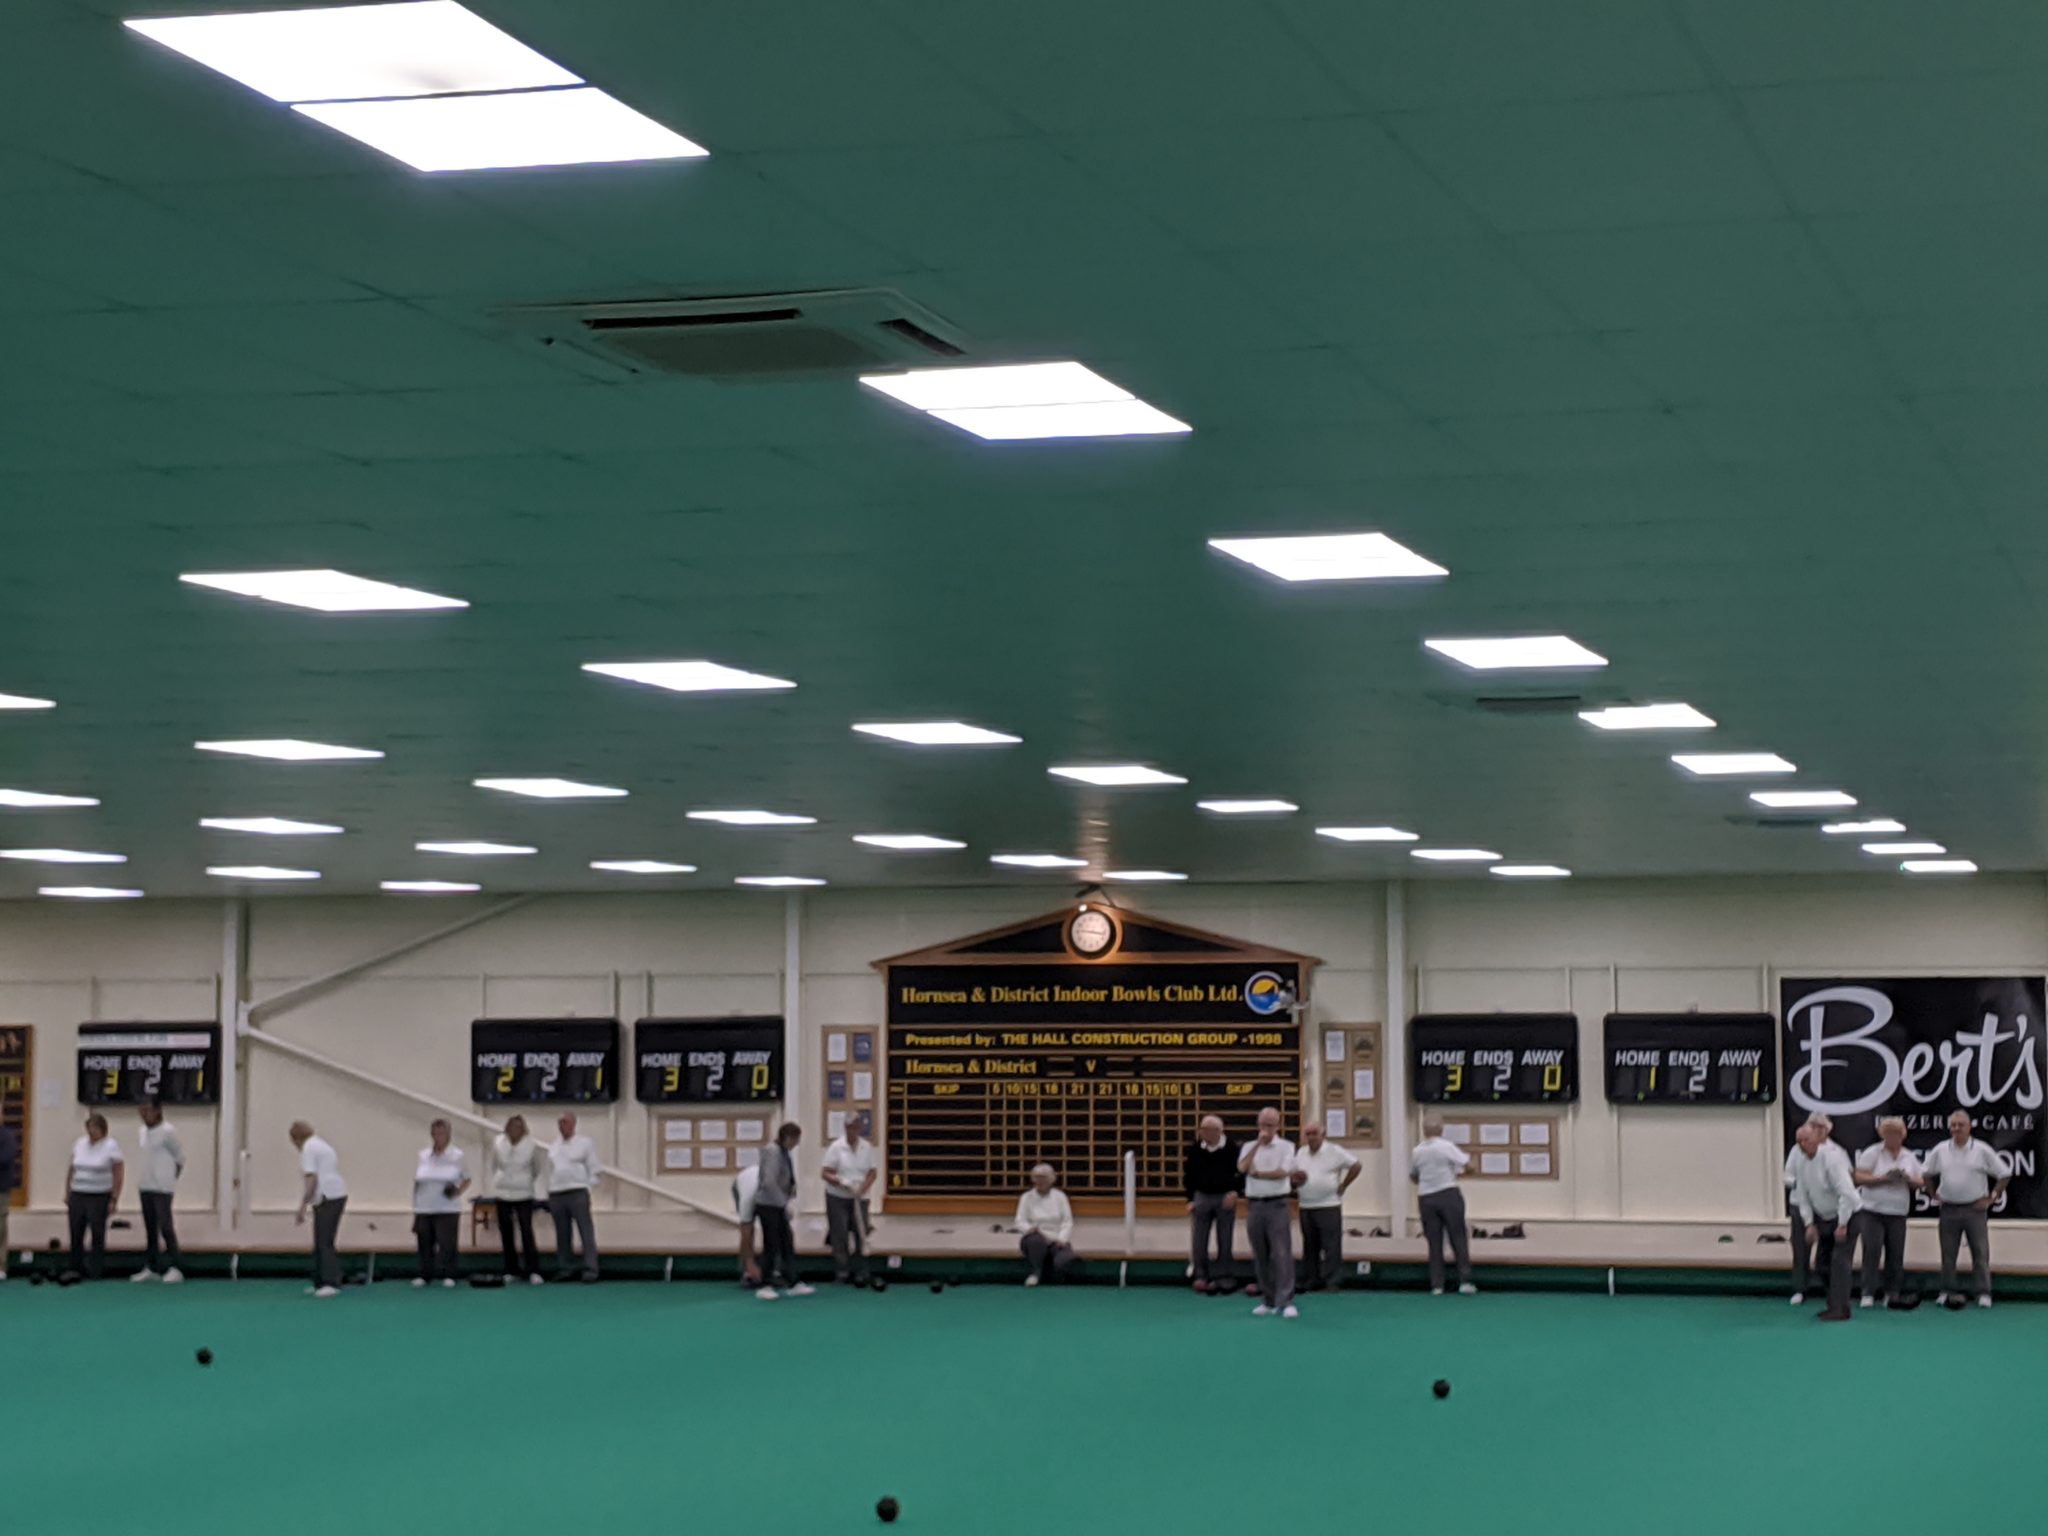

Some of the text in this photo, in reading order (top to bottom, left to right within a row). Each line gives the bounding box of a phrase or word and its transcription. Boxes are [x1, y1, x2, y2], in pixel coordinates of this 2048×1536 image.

[902, 984, 1243, 1003] Hornsea & District Indoor Bowls Club Ltd.
[905, 1033, 971, 1046] Presented
[975, 1033, 996, 1047] by:
[1002, 1033, 1028, 1045] THE
[1032, 1033, 1067, 1045] HALL
[1071, 1033, 1184, 1045] CONSTRUCTION
[1187, 1033, 1238, 1045] GROUP
[641, 1051, 771, 1067] HOME ENDS AWAY
[1421, 1050, 1564, 1067] HOME ENDS AWAY
[1615, 1050, 1762, 1067] HOME ENDS AWAY
[1787, 985, 2044, 1116] Bert's
[83, 1054, 206, 1070] HOME ENDS AWAY
[478, 1052, 604, 1068] HOME ENDS AWAY
[905, 1059, 964, 1074] Hornsea
[967, 1059, 980, 1073] &
[984, 1059, 1037, 1074] District
[104, 1069, 119, 1095] 3
[144, 1069, 161, 1094] 2
[497, 1067, 515, 1092] 2
[541, 1067, 558, 1092] 2
[663, 1064, 769, 1091] 3 2 0
[1445, 1065, 1562, 1091] 3 2 0
[1688, 1066, 1707, 1092] 2
[934, 1084, 960, 1094] SKIP
[1024, 1083, 1037, 1095] 15
[1071, 1083, 1084, 1095] 21
[1099, 1083, 1112, 1095] 21
[1226, 1084, 1253, 1094] SKIP
[1982, 1112, 2034, 1130] CAFÉ
